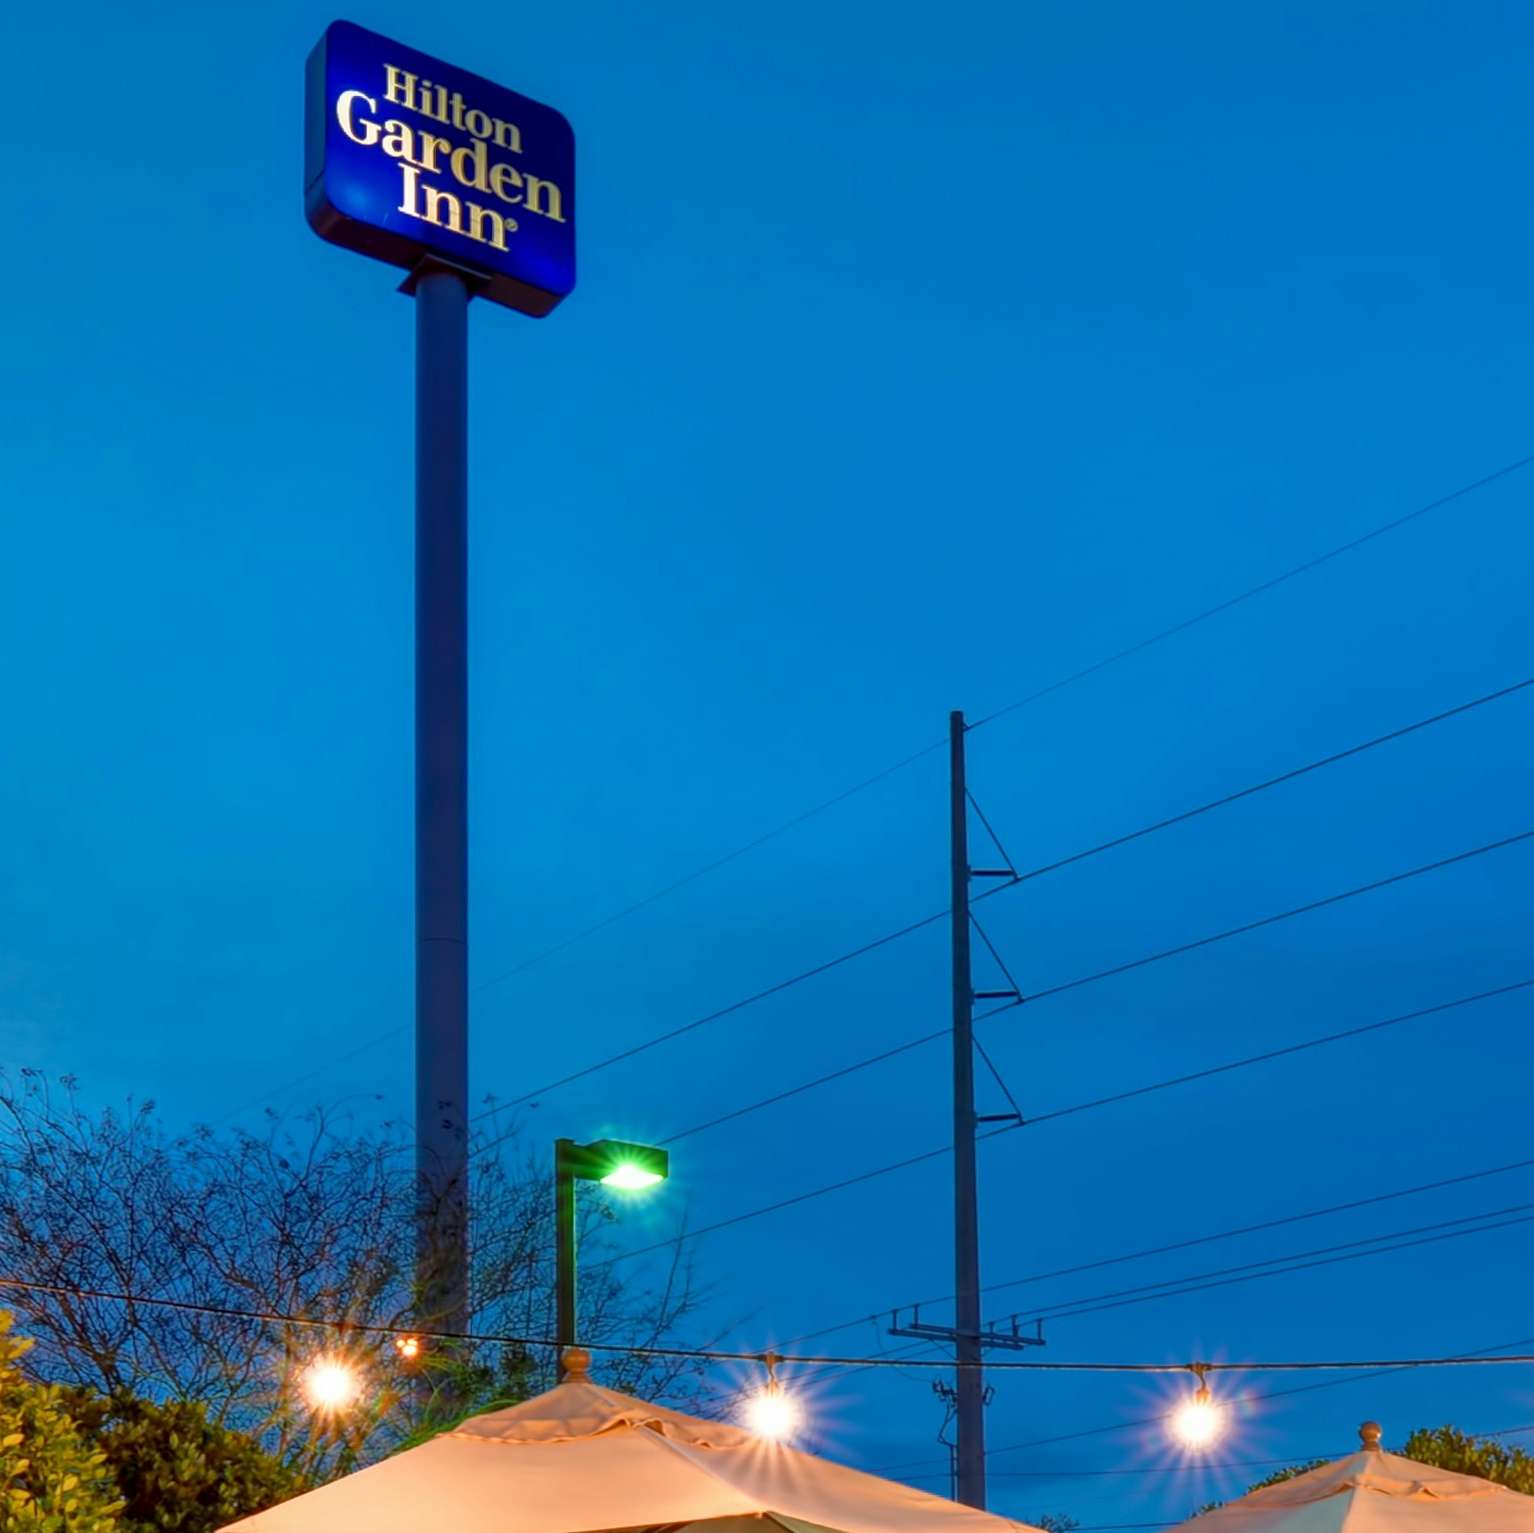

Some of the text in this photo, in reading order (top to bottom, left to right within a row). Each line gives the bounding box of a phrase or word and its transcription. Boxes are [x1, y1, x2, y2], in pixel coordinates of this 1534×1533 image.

[383, 63, 523, 154] Hilton
[336, 89, 566, 223] Garden
[398, 162, 511, 252] Inn
